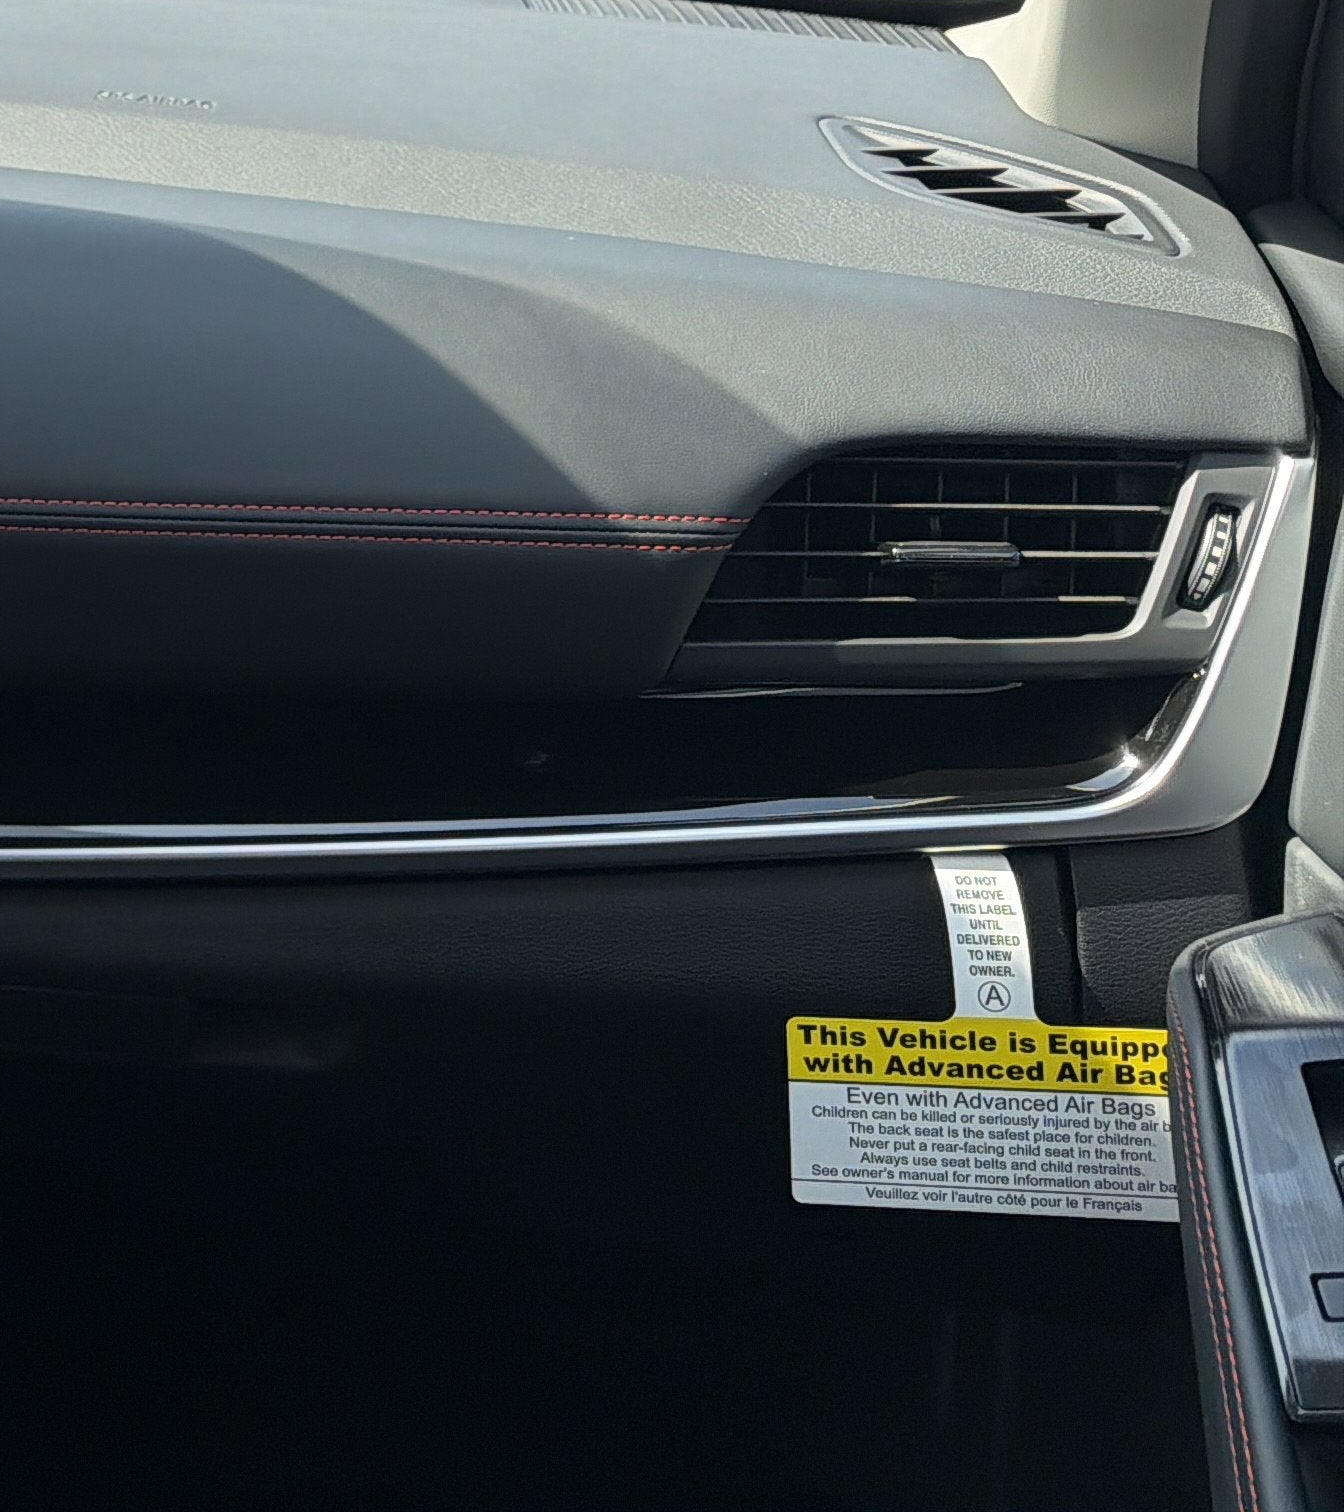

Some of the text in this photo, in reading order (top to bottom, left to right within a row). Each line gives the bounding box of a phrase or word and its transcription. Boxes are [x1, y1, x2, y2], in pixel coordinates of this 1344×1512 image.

[955, 876, 997, 886] DO NOT
[957, 890, 1004, 900] REMOVE
[950, 903, 1017, 915] THIS LABEL
[970, 919, 1002, 930] UNTIL
[957, 934, 1020, 946] DELIVERED
[967, 950, 1012, 961] TO NEW
[969, 965, 1015, 977] OWNER.
[985, 985, 1005, 1006] A
[797, 1024, 1168, 1062] This Vehicle is Equipp
[804, 1053, 873, 1074] with
[884, 1055, 1044, 1081] Advanced
[1056, 1062, 1104, 1084] Air
[847, 1087, 1156, 1119] Even with Advanced Air Bags
[812, 1105, 868, 1119] Children
[872, 1110, 896, 1121] can
[900, 1109, 917, 1121] be
[921, 1109, 956, 1123] killed
[960, 1114, 975, 1124] or
[978, 1115, 1039, 1129] seriously
[1043, 1116, 1090, 1132] injured
[1094, 1118, 1110, 1132] by
[1114, 1119, 1136, 1131] the
[1140, 1121, 1159, 1132] air
[849, 1122, 1156, 1147] The back seat is the safest place for children.
[849, 1137, 1156, 1162] Never put a rear-facing child seat in the front.
[860, 1152, 1145, 1176] Always use seat belts and child restraints.
[812, 1165, 1155, 1192] See owner's manual for more information about air
[866, 1187, 1143, 1213] Veuillez voir l'autre côté pour le Français
